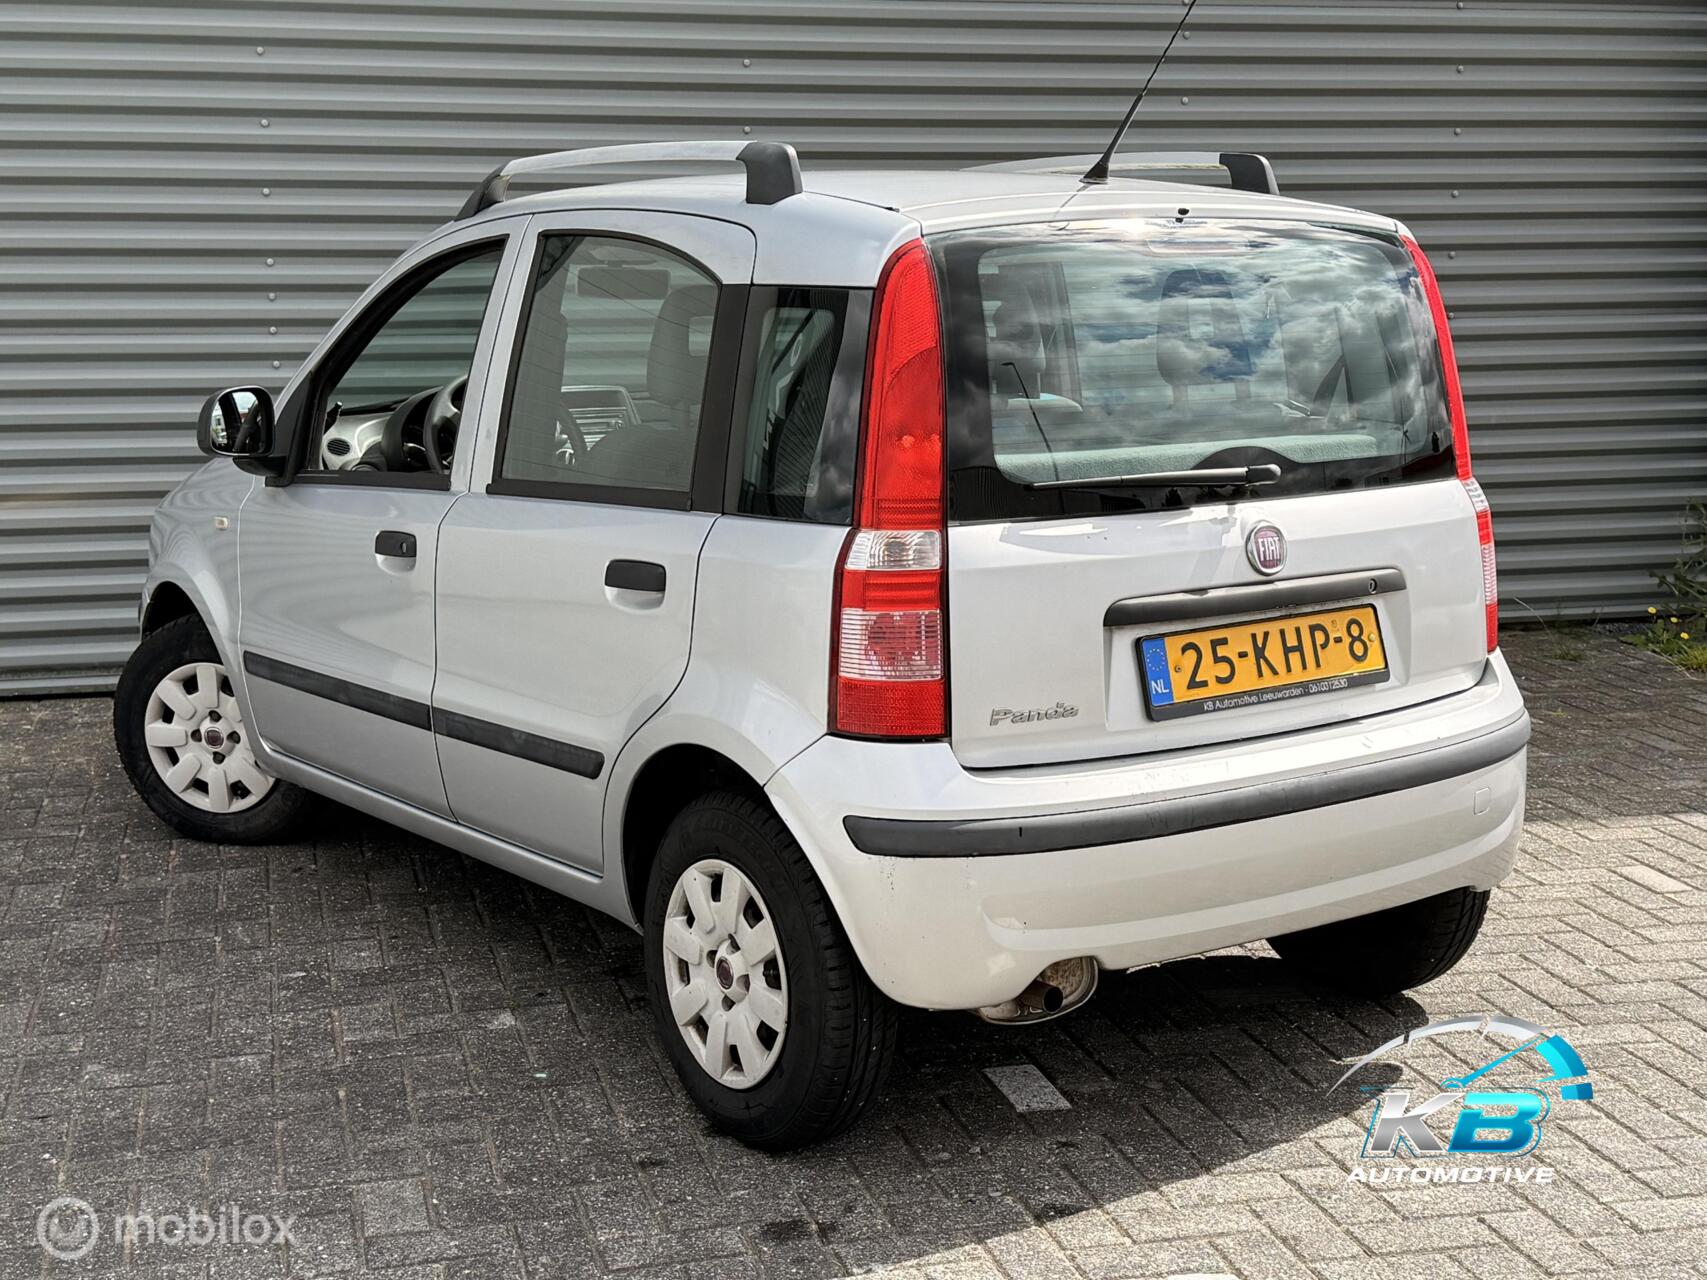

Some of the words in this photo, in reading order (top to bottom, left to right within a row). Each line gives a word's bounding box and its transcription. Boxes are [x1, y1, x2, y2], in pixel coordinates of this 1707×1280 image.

[1258, 536, 1280, 562] FIAT
[1180, 617, 1369, 690] 25-KHP-8
[1151, 680, 1169, 694] NL
[1203, 701, 1214, 711] KB
[1215, 696, 1258, 709] Automotive
[1259, 688, 1304, 702] Leeuwarden
[990, 702, 1080, 727] Panda
